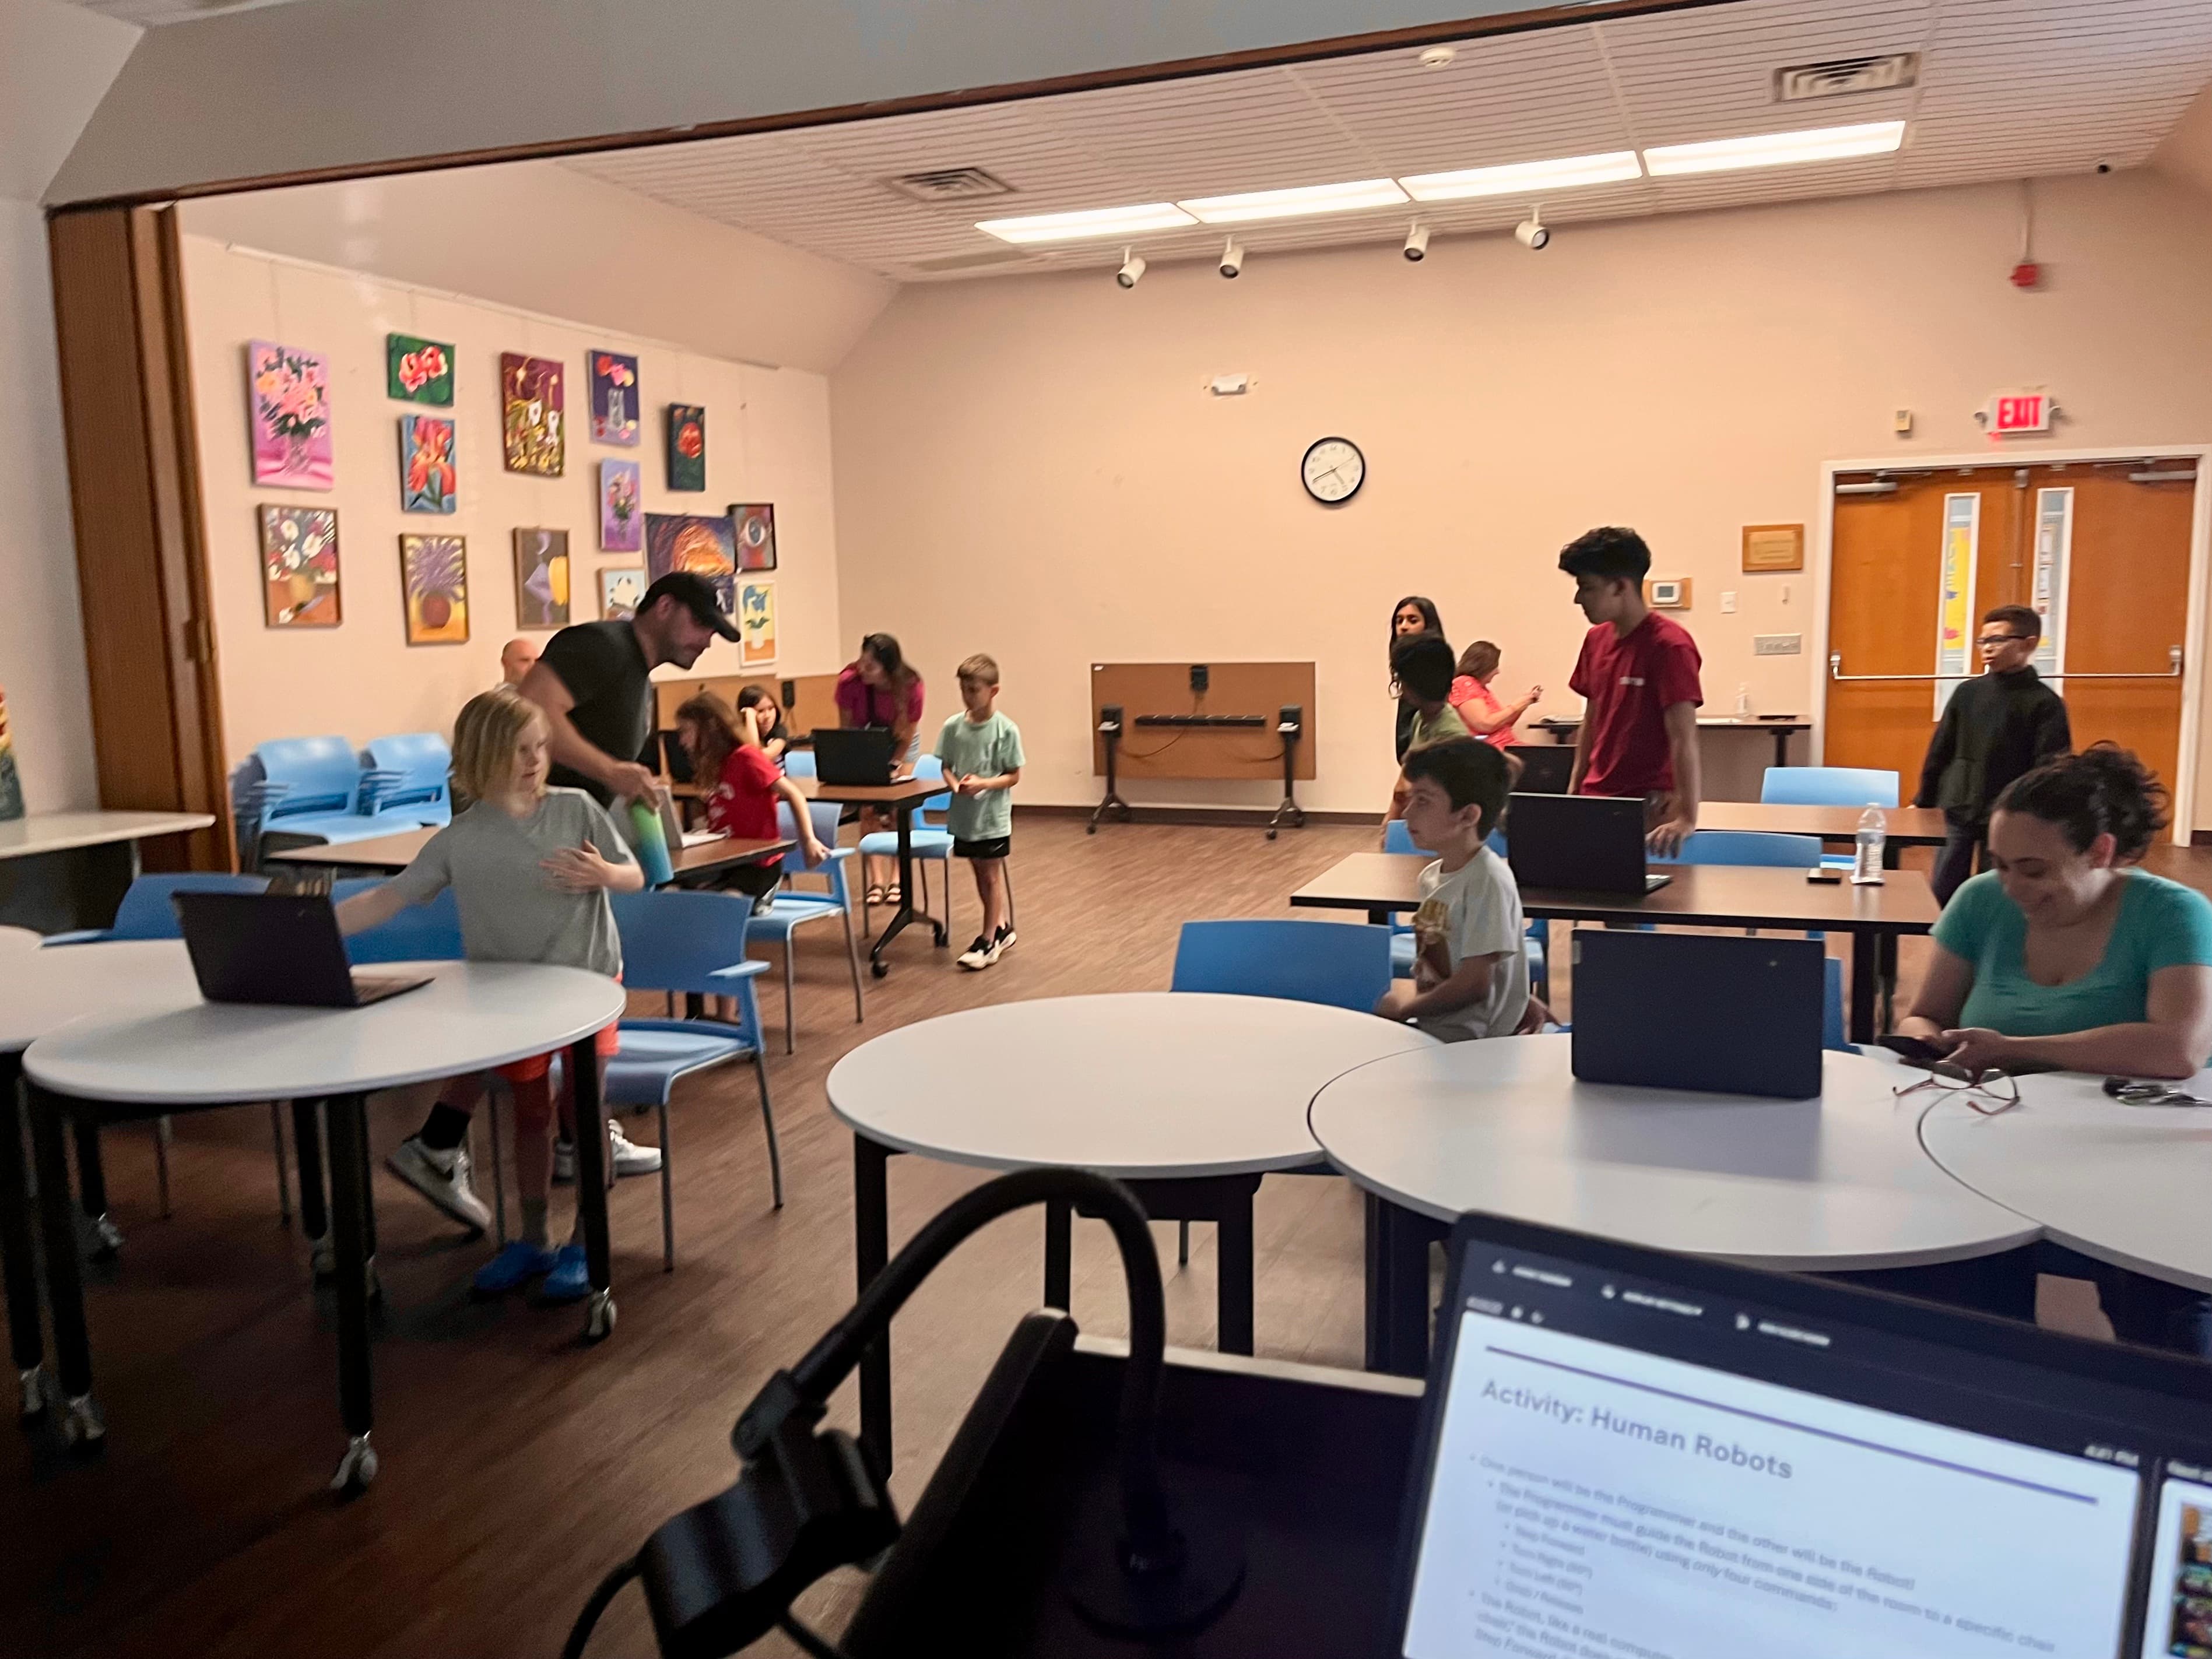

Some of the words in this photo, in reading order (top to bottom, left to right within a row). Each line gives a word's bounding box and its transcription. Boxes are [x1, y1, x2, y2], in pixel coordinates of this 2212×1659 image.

[1997, 396, 2043, 428] EXIT
[1481, 1379, 1583, 1425] Activity:
[1590, 1405, 1686, 1451] Human
[1694, 1433, 1793, 1479] Robots
